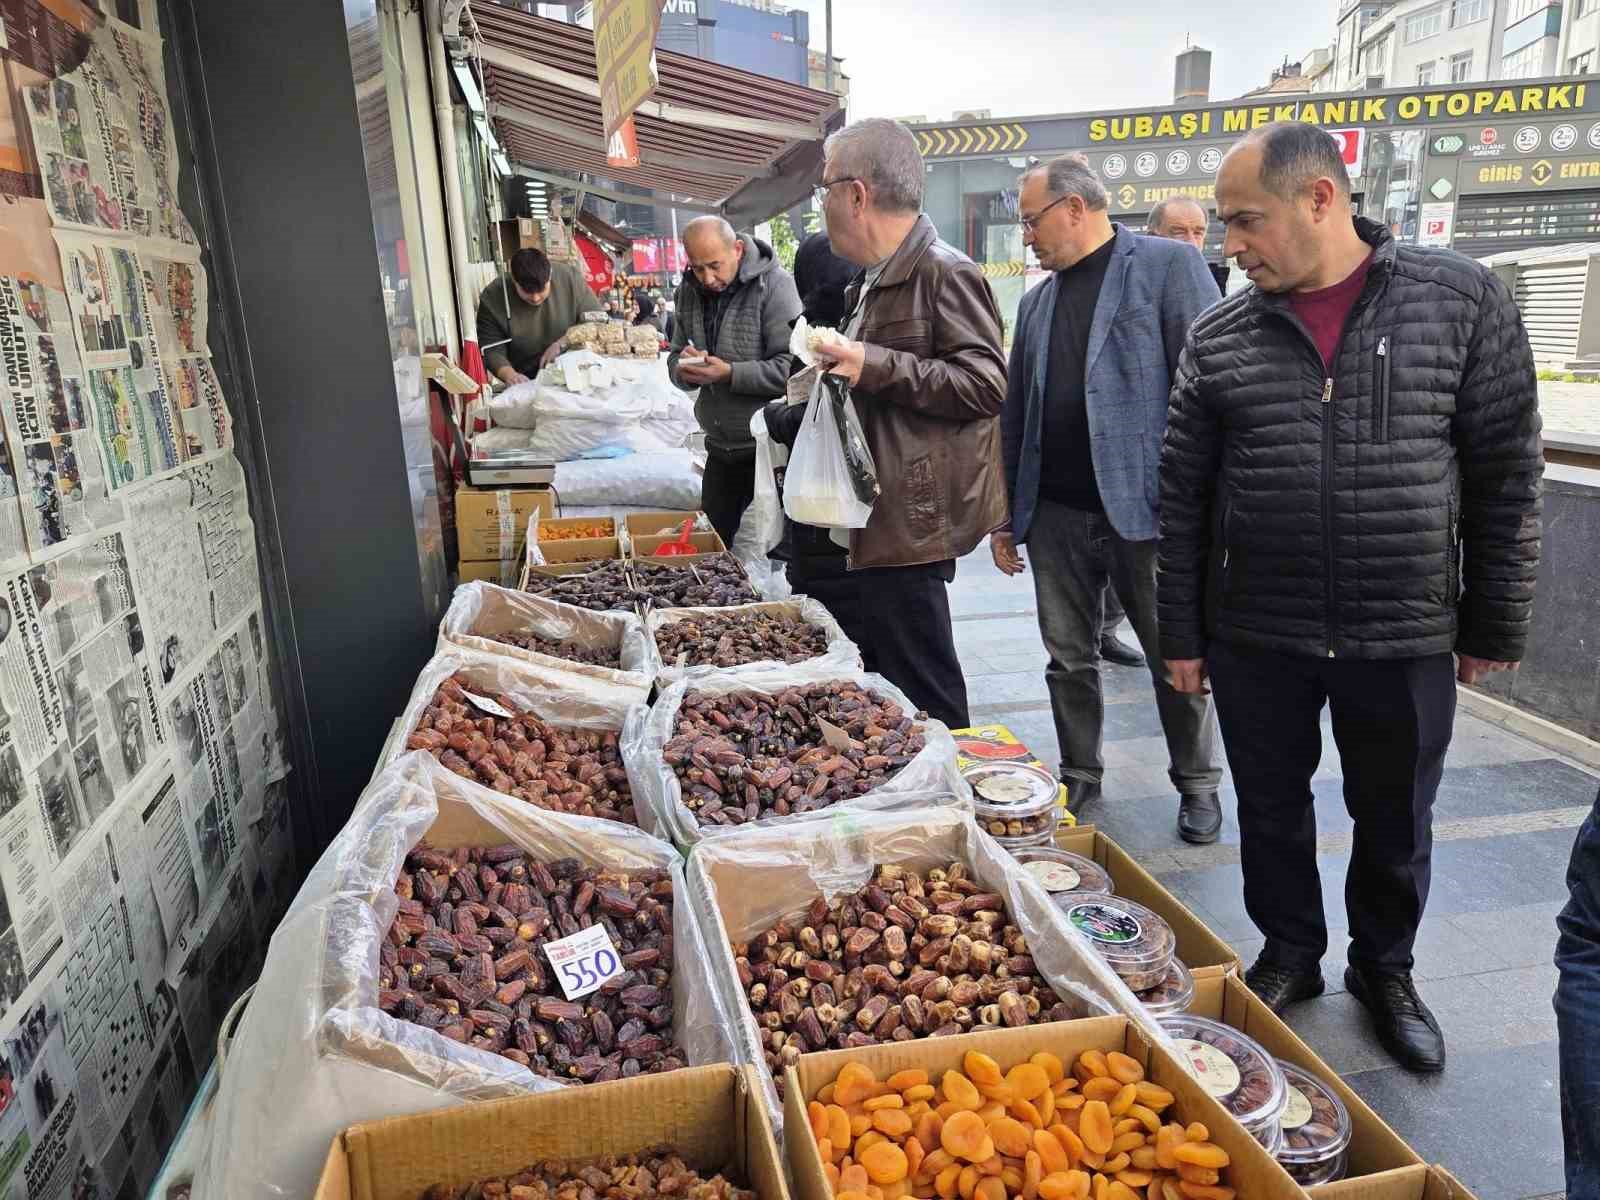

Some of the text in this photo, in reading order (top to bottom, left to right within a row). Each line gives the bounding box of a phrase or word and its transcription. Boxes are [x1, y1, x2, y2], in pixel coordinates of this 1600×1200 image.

[1089, 111, 1210, 141] SUBAŞI
[1398, 84, 1587, 119] OTOPARKI
[1479, 164, 1523, 184] GİRİŞ
[12, 322, 33, 389] UMUT
[7, 580, 25, 621] nasıl
[18, 573, 36, 620] Kabız
[31, 622, 57, 698] olmamak
[561, 949, 617, 992] 550
